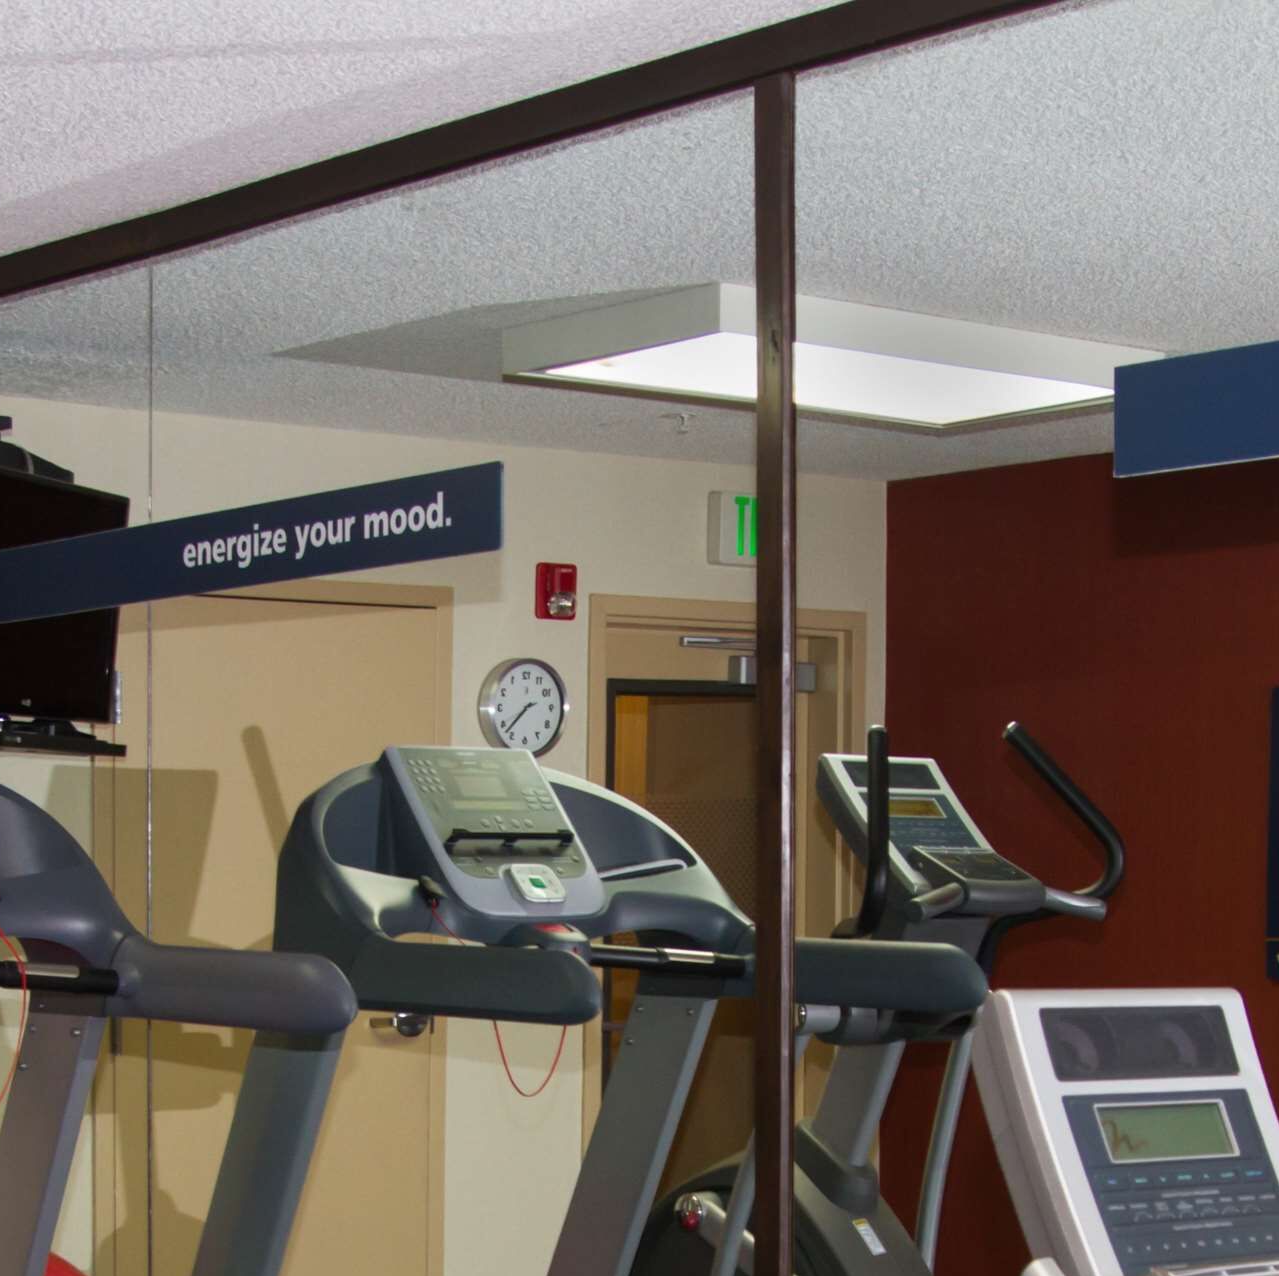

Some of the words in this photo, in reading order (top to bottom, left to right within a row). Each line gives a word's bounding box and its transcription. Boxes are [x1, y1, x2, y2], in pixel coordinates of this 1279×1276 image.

[183, 523, 287, 568] energize
[295, 515, 355, 560] your
[363, 491, 452, 540] mood.
